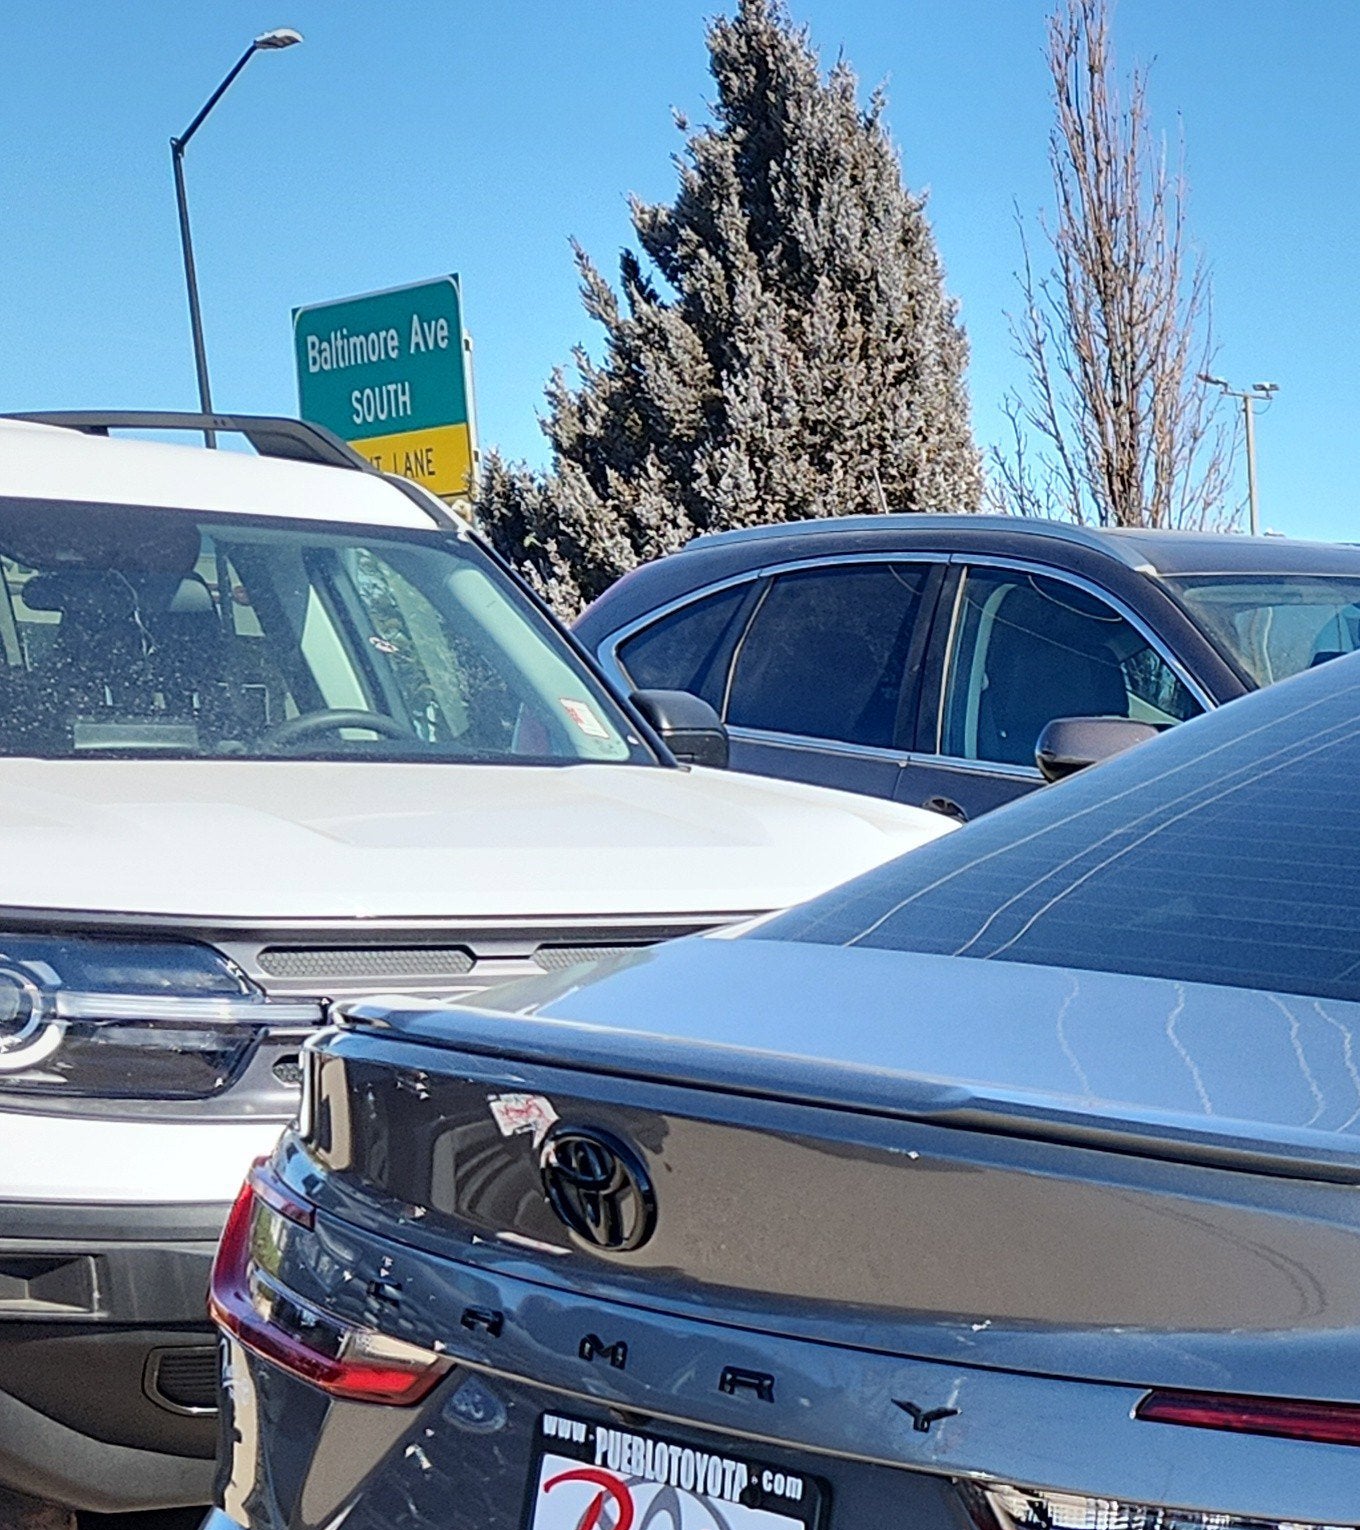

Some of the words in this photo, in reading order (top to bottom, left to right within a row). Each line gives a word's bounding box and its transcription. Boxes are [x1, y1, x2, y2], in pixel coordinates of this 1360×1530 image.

[307, 328, 399, 373] Baltimore
[410, 314, 449, 354] Ave
[351, 381, 412, 425] SOUTH
